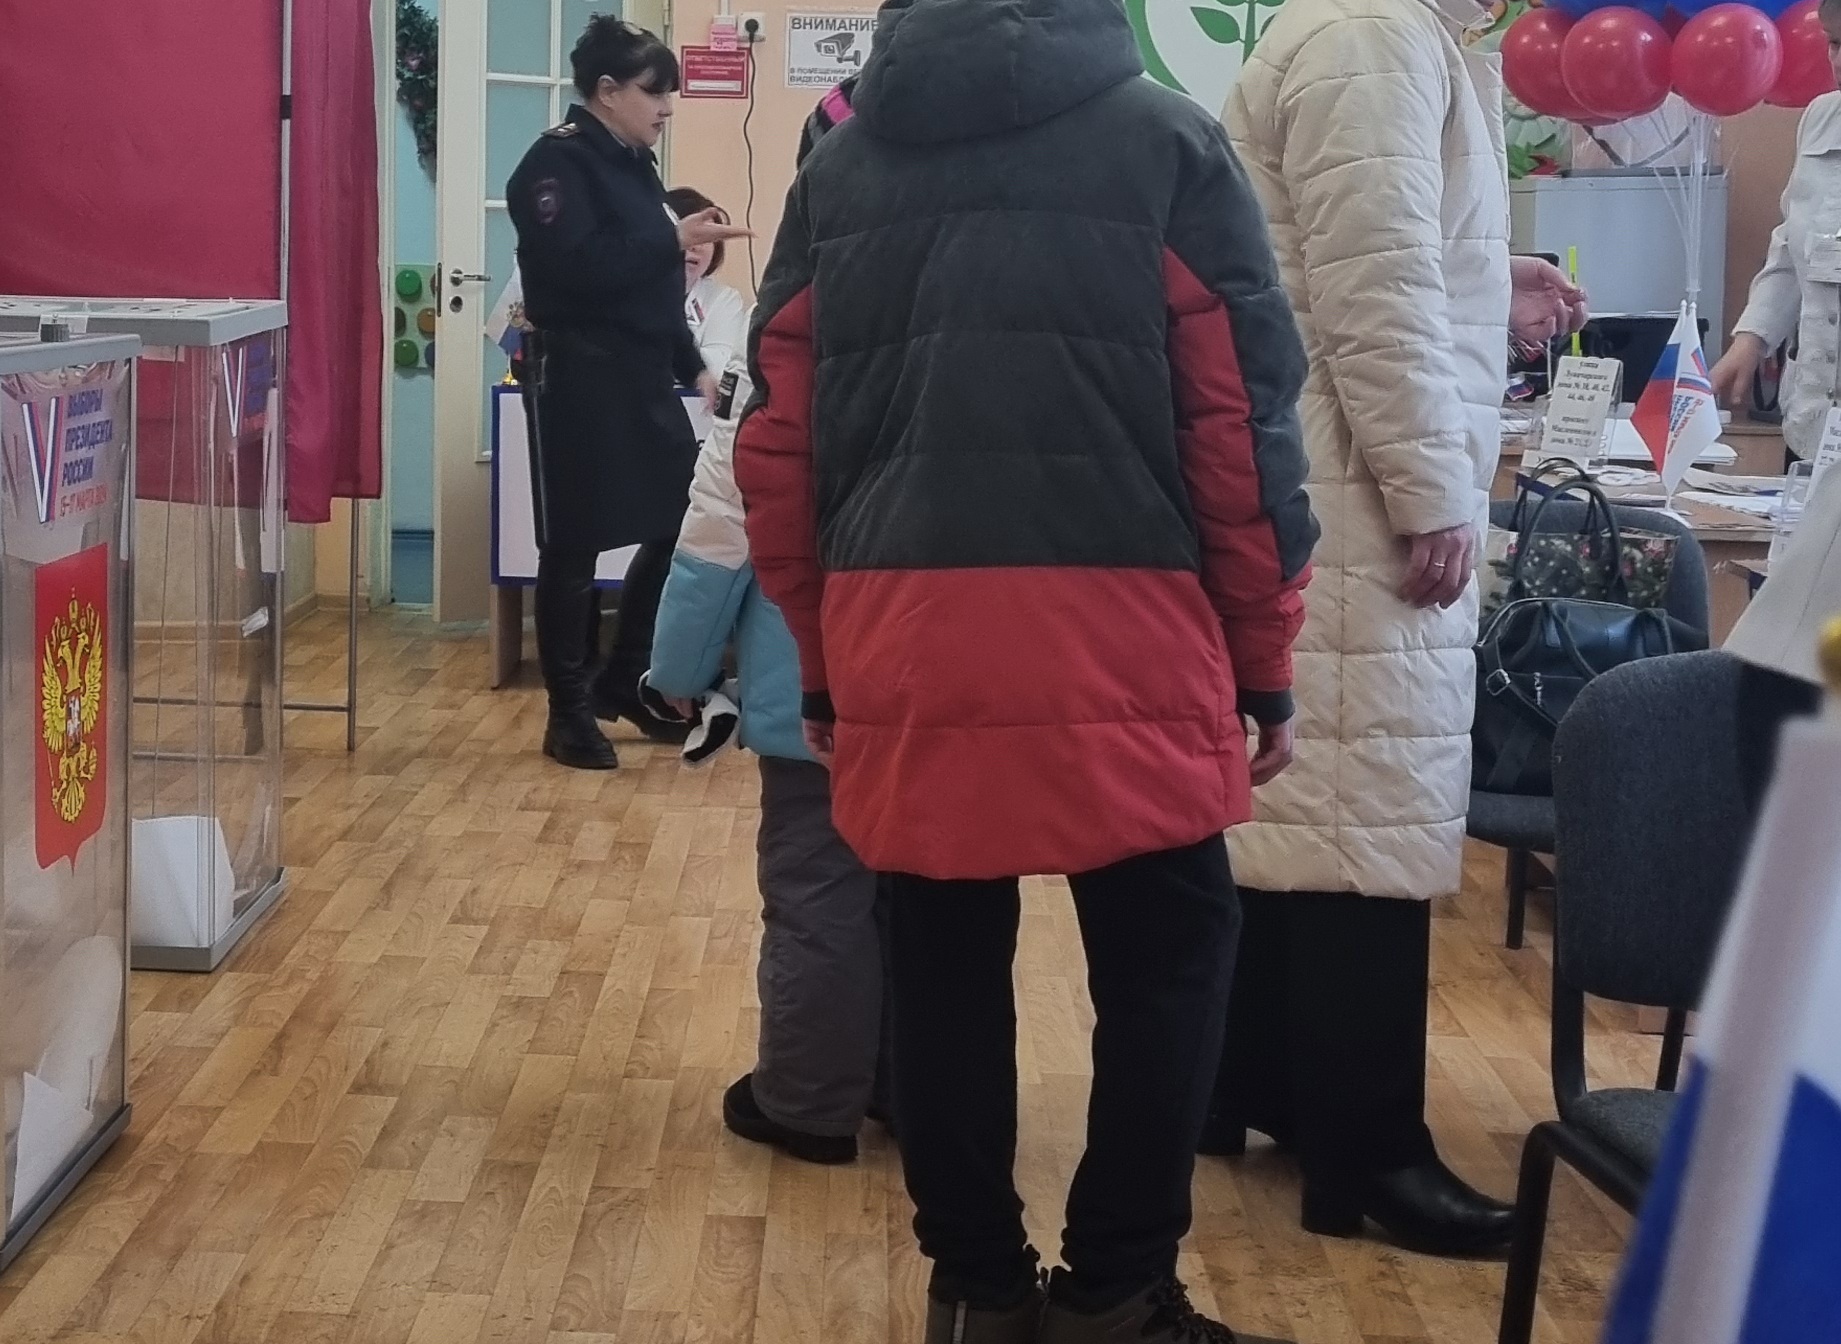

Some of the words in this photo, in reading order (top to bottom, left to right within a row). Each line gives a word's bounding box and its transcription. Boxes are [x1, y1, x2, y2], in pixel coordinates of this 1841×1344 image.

[67, 388, 104, 419] ВЫБОРЫ
[64, 419, 113, 453] ПРЕЗИДЕНТА
[62, 456, 94, 487] РОССИИ
